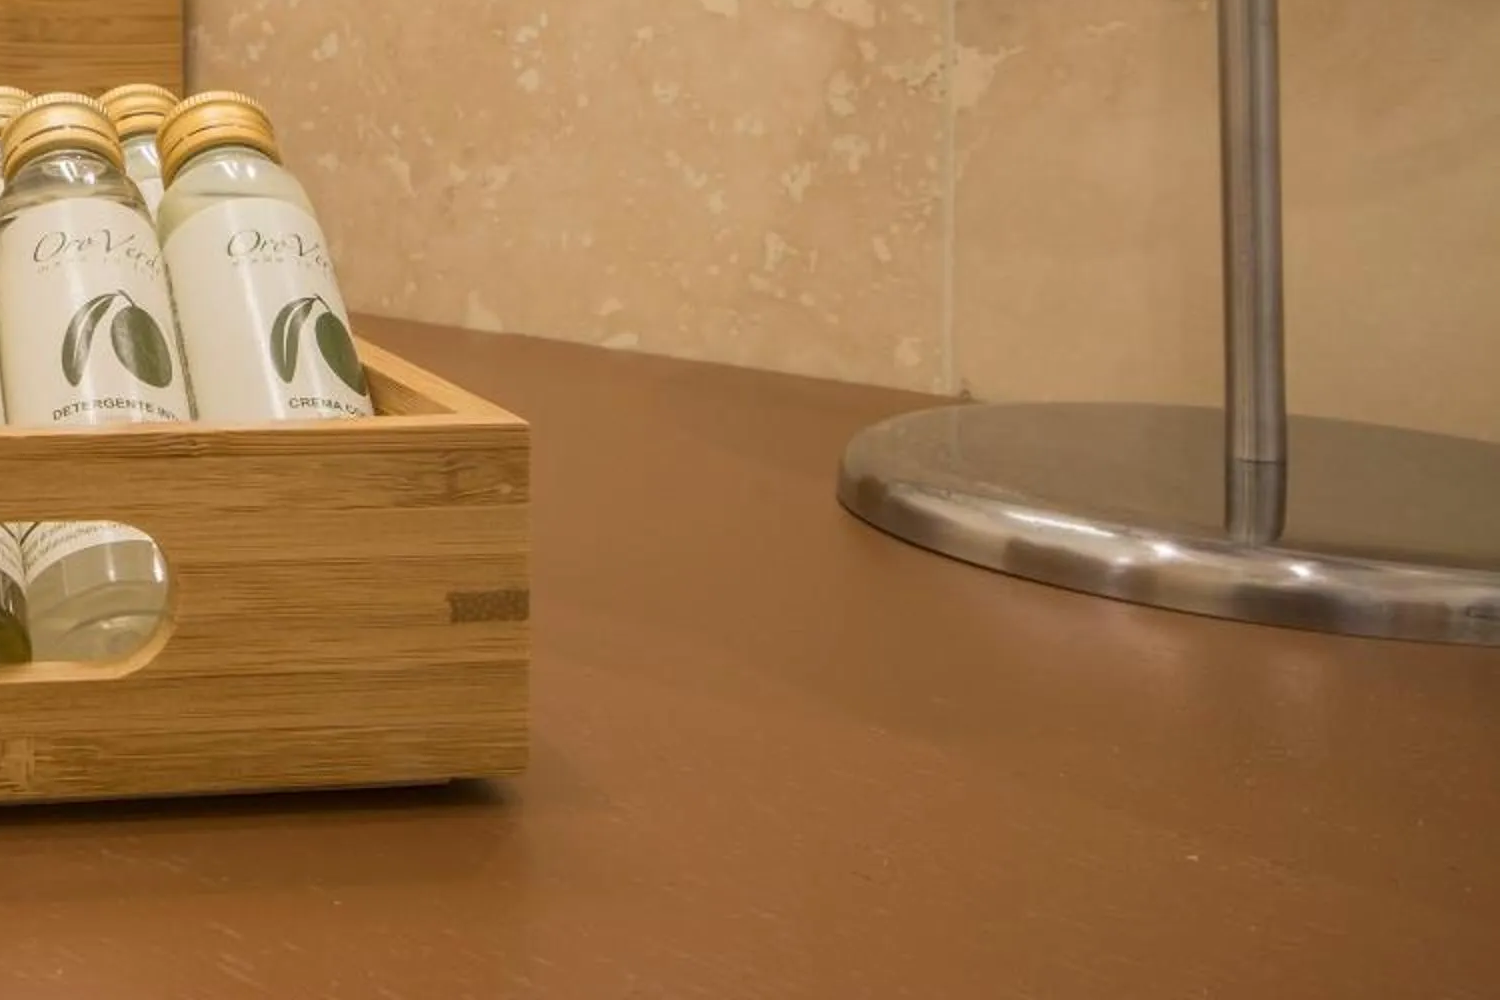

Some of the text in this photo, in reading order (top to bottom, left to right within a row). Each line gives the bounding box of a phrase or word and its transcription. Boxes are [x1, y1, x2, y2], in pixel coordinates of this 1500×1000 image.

[33, 230, 96, 262] Oro
[227, 229, 288, 257] Oro
[52, 397, 155, 422] DETERGENTE
[288, 397, 344, 412] CREMA
